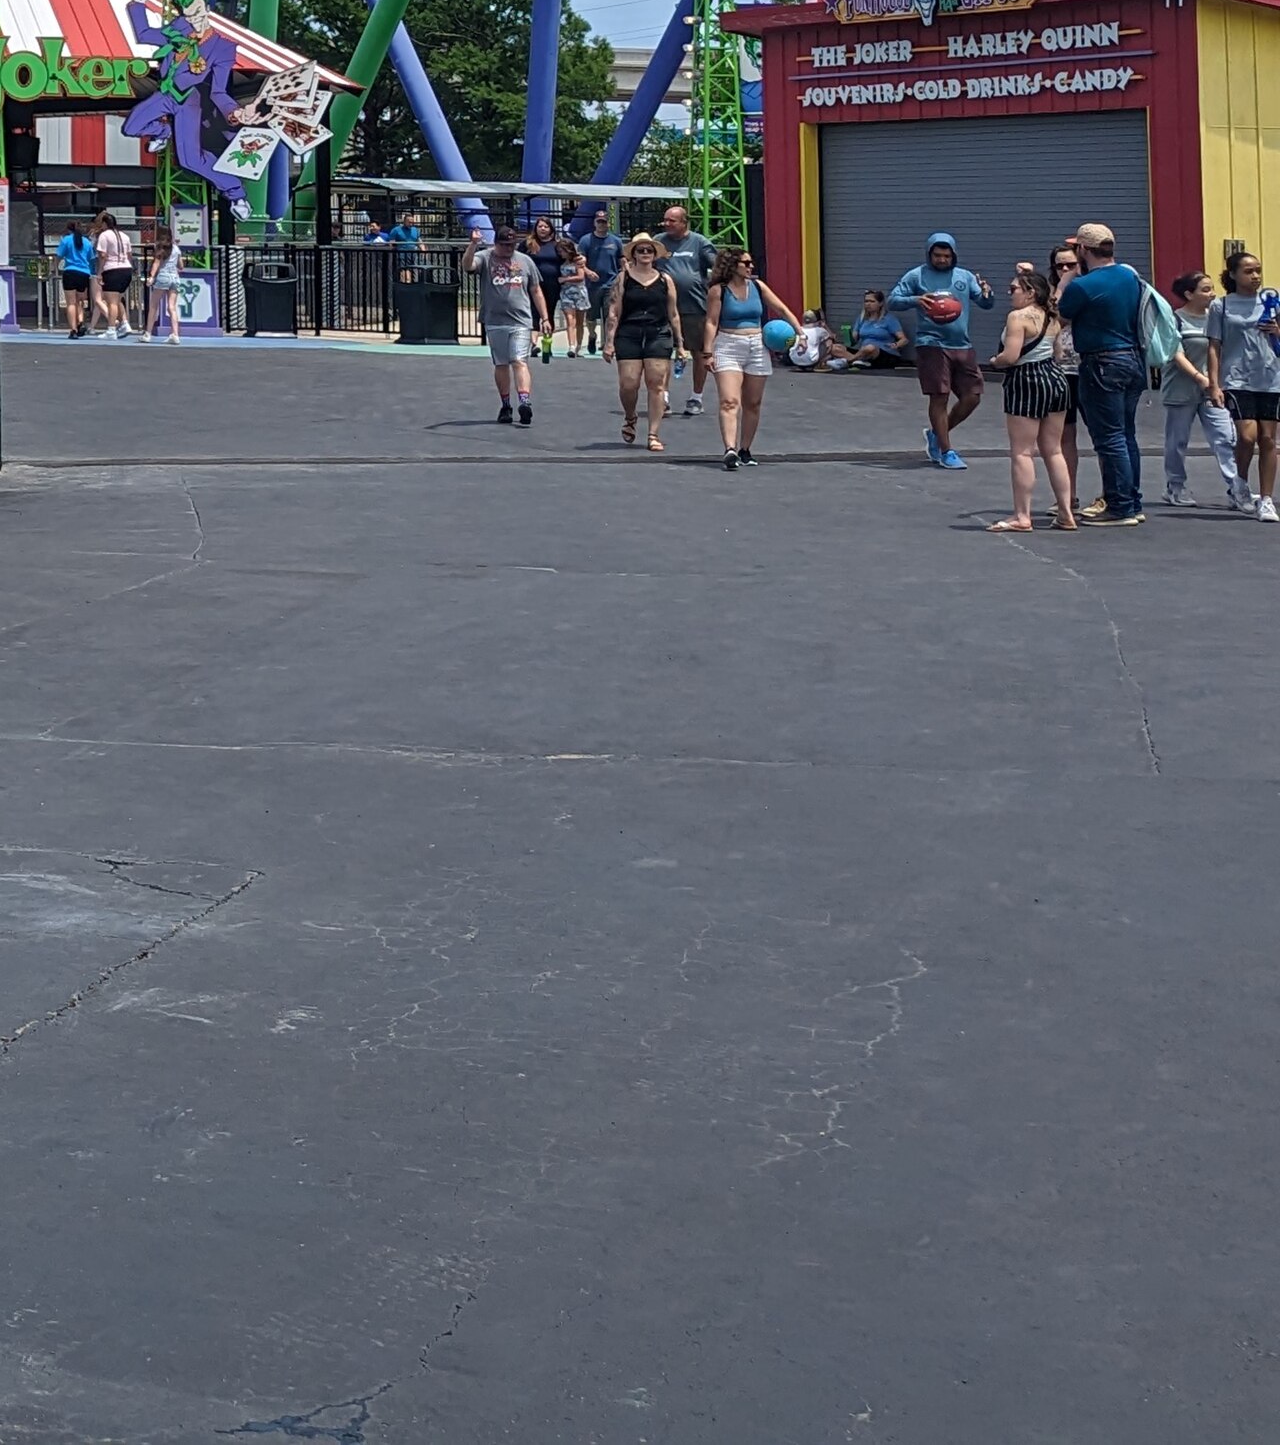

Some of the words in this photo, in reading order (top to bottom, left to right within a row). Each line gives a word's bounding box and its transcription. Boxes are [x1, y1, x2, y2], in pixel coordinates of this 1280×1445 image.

[811, 44, 847, 68] THE
[853, 39, 913, 66] JOKER
[947, 28, 1035, 58] HARLEY
[1040, 21, 1120, 52] QUINN
[802, 81, 906, 107] SOUVENIRS
[913, 78, 961, 100] COLD
[965, 71, 1042, 99] DRINKS
[1054, 65, 1134, 94] CANDY
